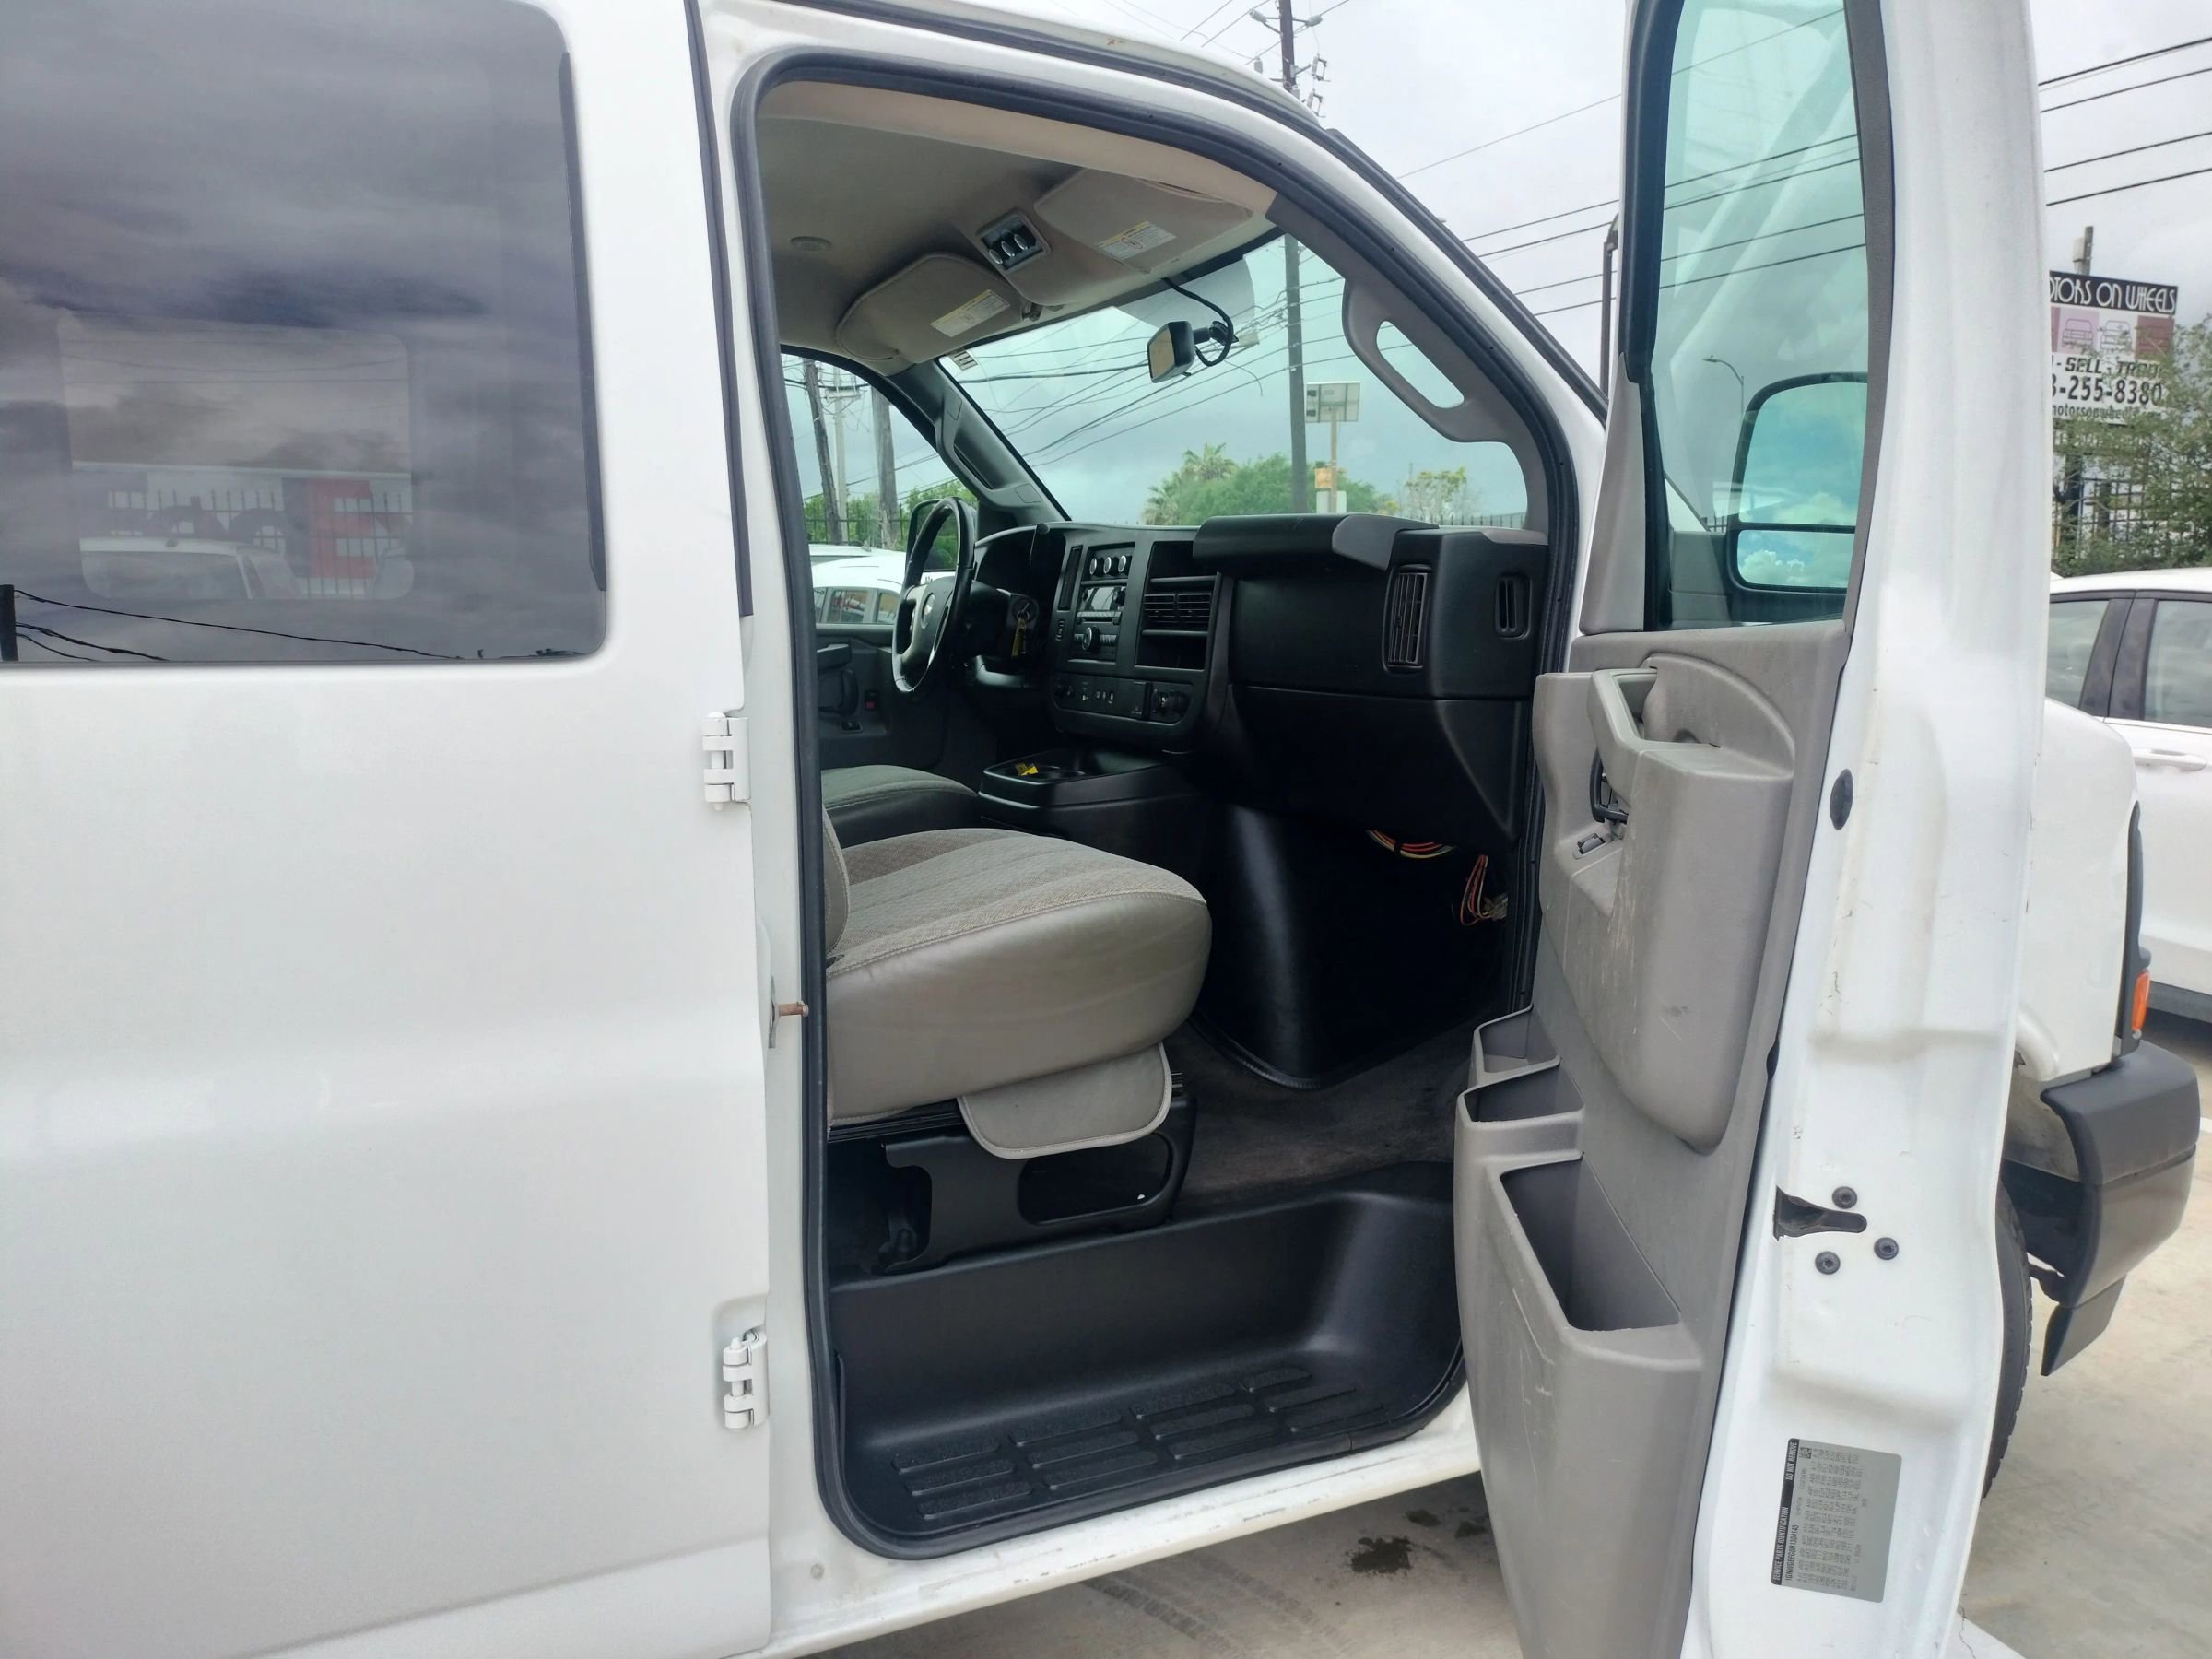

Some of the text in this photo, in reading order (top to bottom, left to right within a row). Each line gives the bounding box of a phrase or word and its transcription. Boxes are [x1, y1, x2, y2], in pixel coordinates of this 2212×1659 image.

[2096, 282, 2122, 308] ON
[2125, 285, 2175, 312] WHEELS
[2065, 357, 2101, 373] SELL
[1787, 1441, 1796, 1462] REMOVE
[1785, 1462, 1794, 1472] NOT
[1784, 1472, 1793, 1480] DO
[1777, 1506, 1788, 1544] IDENTIFICATION
[1775, 1543, 1783, 1560] PARTS
